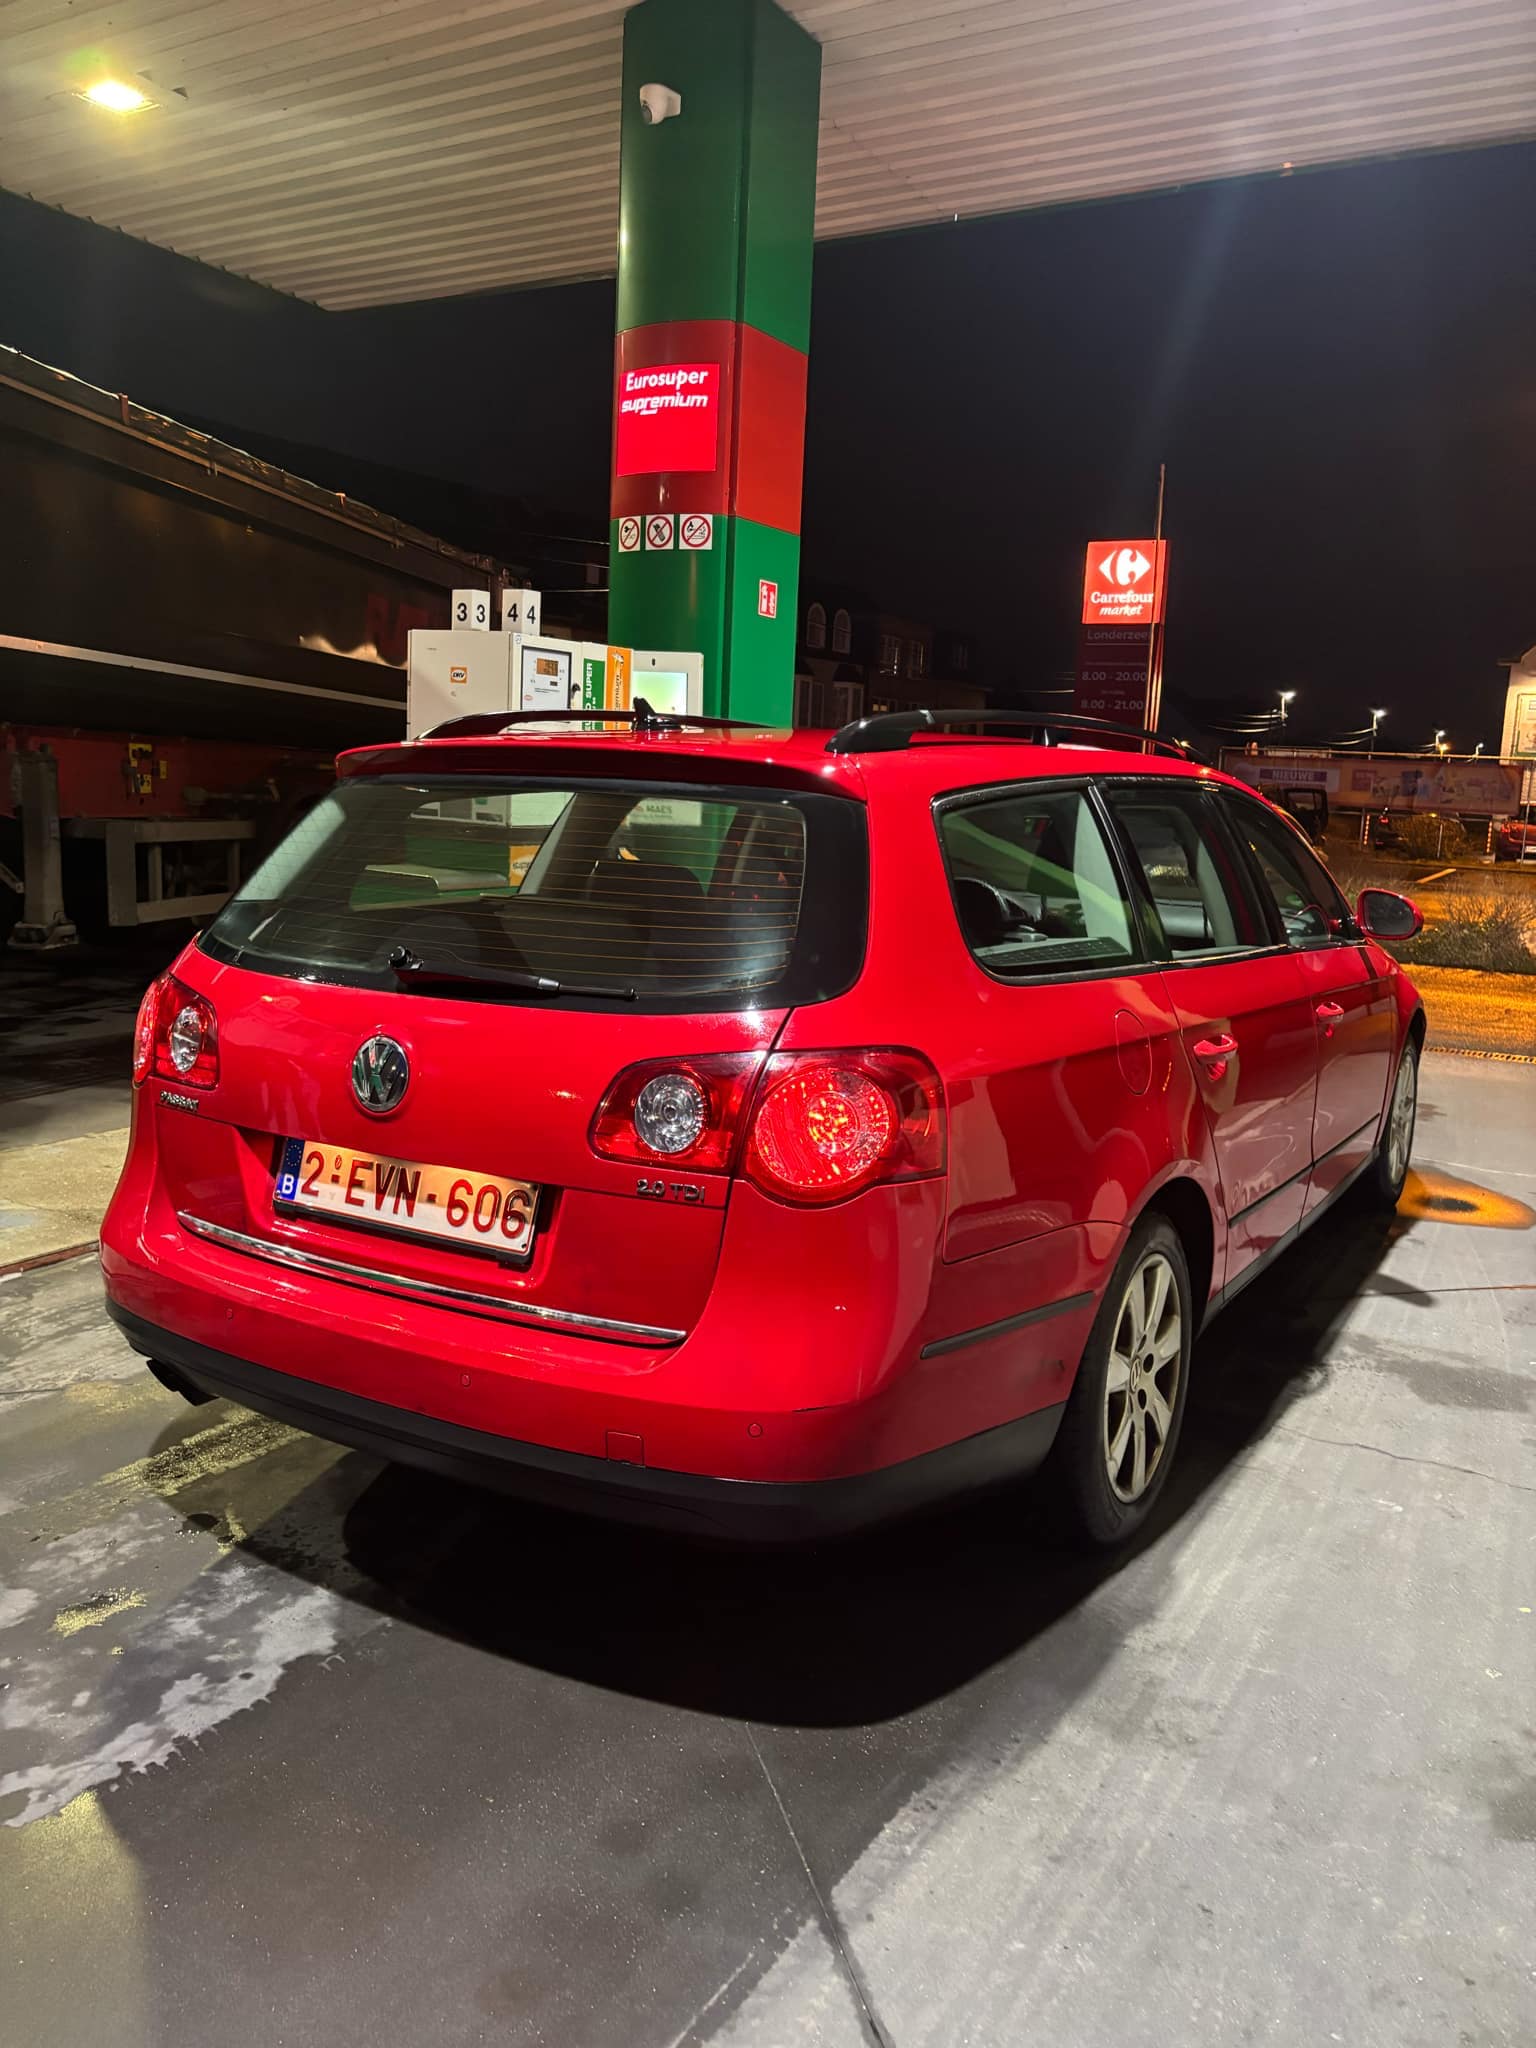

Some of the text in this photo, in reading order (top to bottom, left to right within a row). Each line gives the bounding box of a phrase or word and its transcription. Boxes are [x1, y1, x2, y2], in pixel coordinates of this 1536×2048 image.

[625, 369, 708, 392] Eurosuper
[621, 391, 708, 415] supremium
[1090, 588, 1154, 604] Carrefour
[456, 602, 467, 622] 3
[476, 604, 486, 623] 3
[507, 603, 518, 622] 4
[526, 605, 536, 624] 4
[1098, 604, 1143, 616] market
[585, 662, 593, 698] SUPER
[1271, 769, 1315, 781] NIEUWE
[281, 1173, 294, 1194] B
[637, 1179, 664, 1197] 2.0
